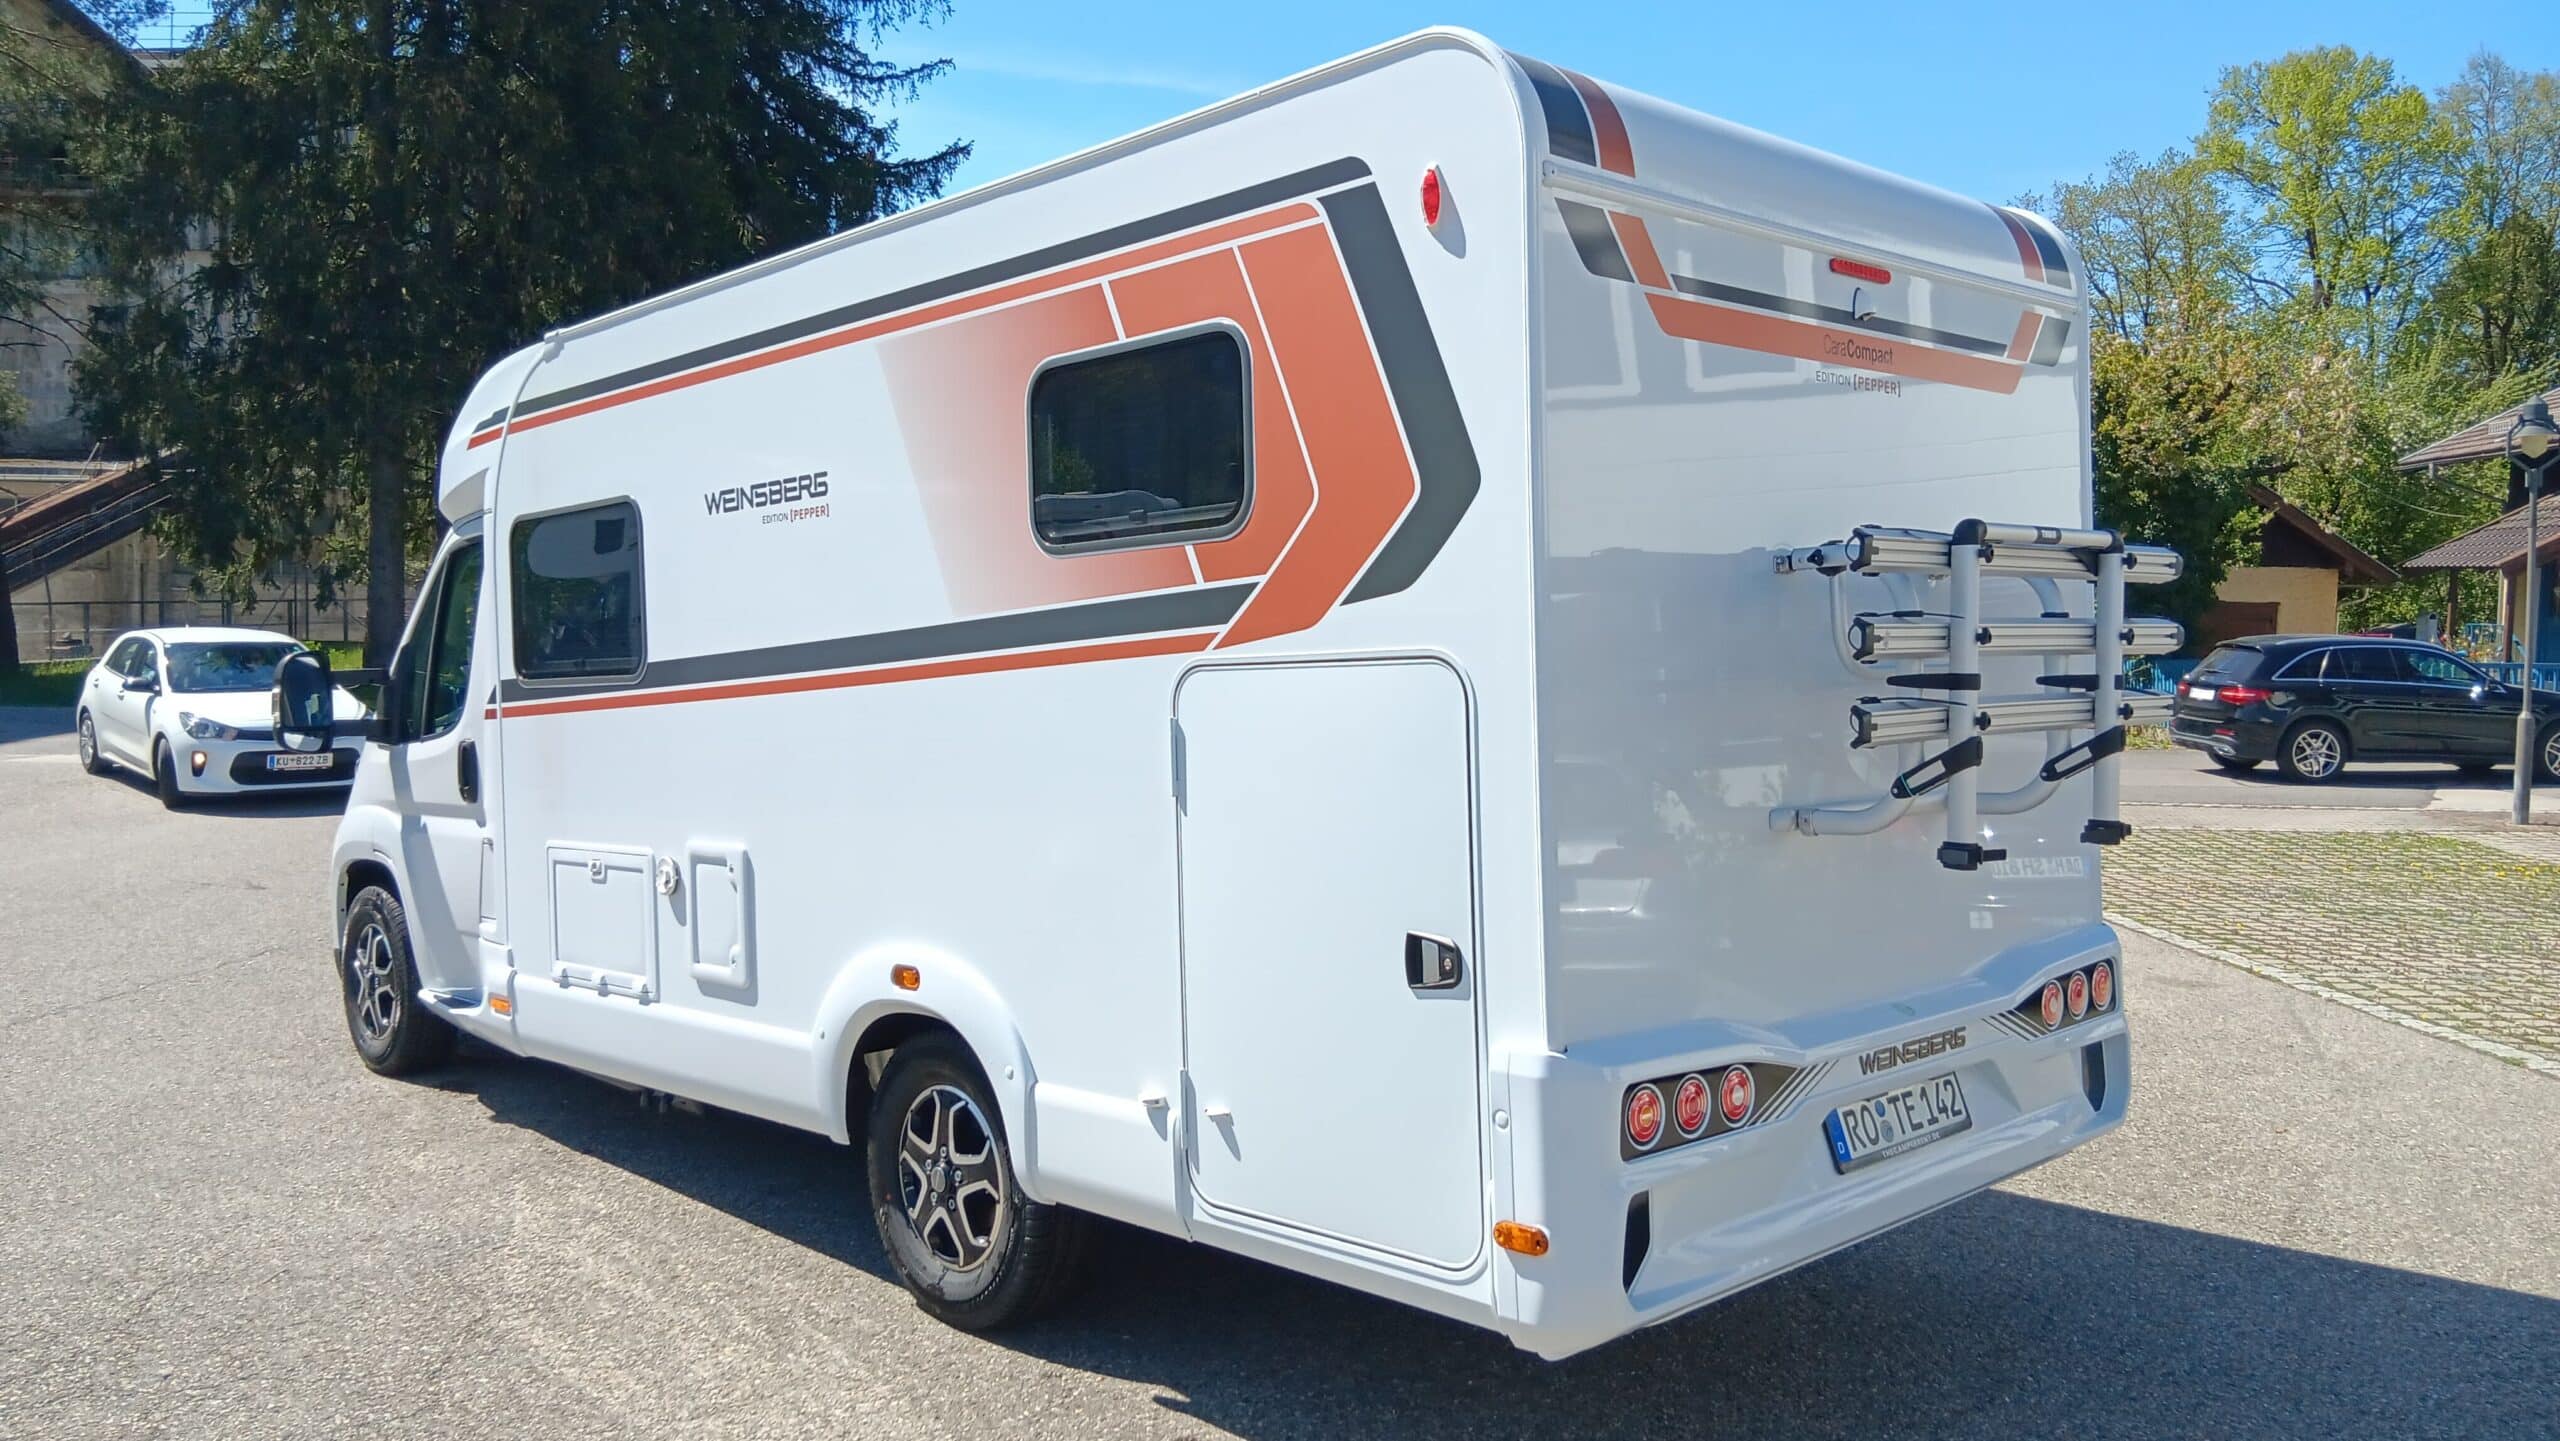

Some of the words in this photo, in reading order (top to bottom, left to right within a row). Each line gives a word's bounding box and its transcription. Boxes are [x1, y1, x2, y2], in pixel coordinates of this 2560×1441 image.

[1823, 334, 1893, 365] CaraCompact
[1815, 370, 1851, 387] EDITION
[704, 470, 828, 516] WEINSBERG
[762, 511, 789, 525] EDITION
[1859, 1026, 1967, 1076] WEINSBERG
[1842, 1103, 1880, 1153] RO
[1886, 1089, 1924, 1135] TE
[1919, 1078, 1962, 1126] 142
[1837, 1141, 1846, 1154] D
